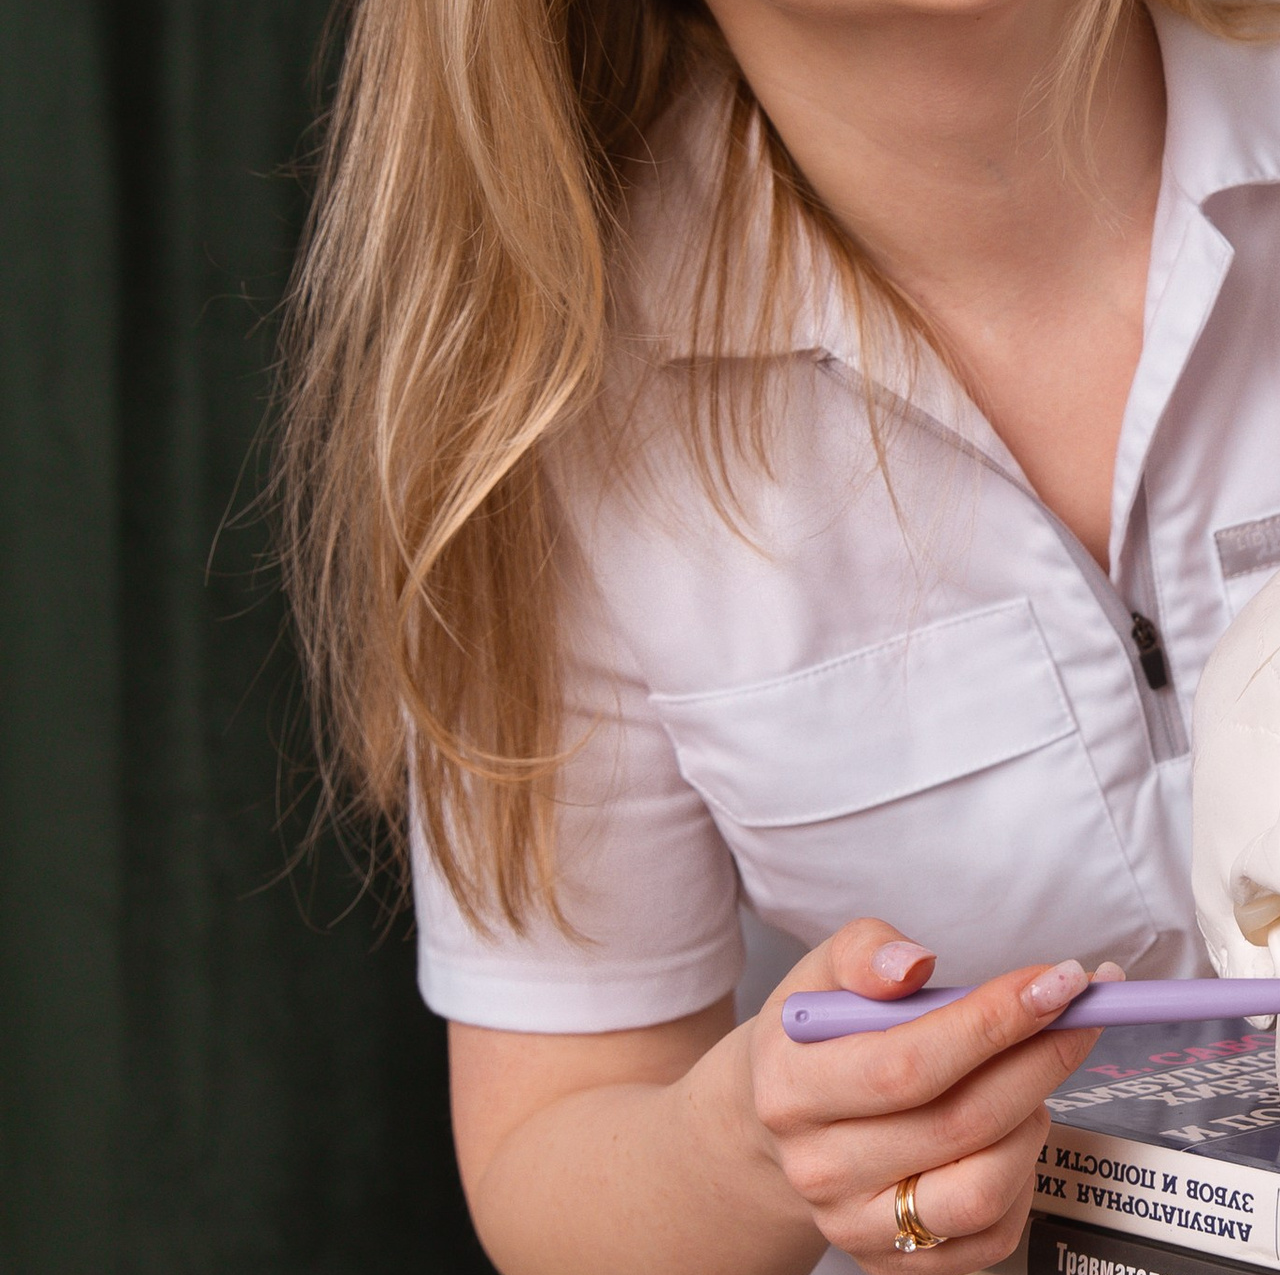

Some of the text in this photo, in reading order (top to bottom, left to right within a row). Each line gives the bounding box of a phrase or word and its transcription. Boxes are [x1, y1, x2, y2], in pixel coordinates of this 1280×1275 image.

[1054, 1148, 1156, 1189] ПОЛОСТИ
[1161, 1173, 1178, 1195] И
[1034, 1173, 1254, 1243] АМБУЛАТОРНАЯ ХИ
[1185, 1179, 1256, 1214] ЗУБОВ
